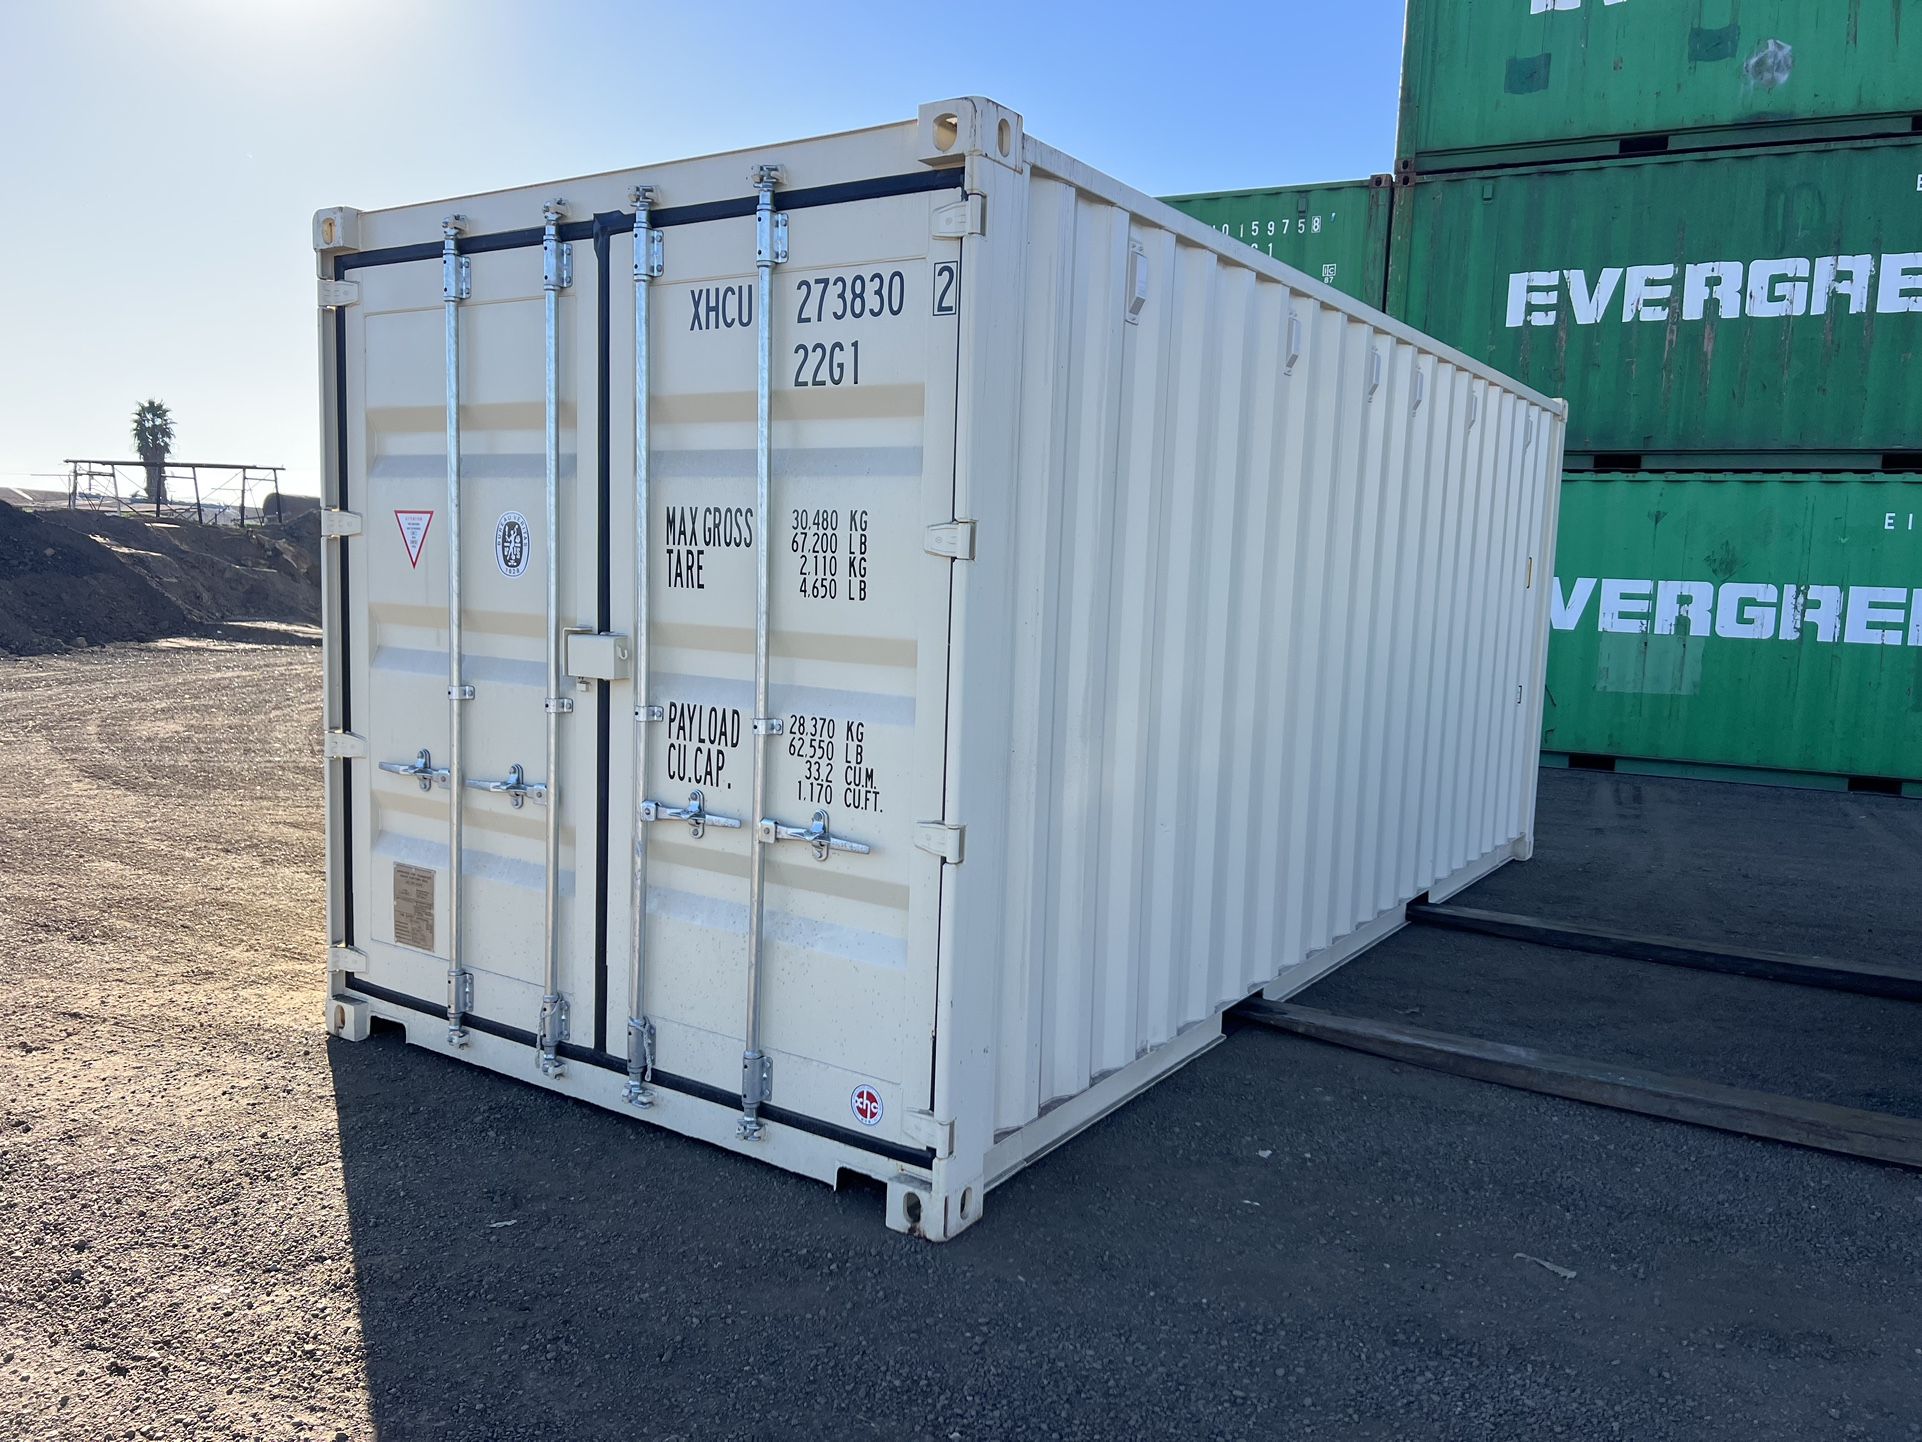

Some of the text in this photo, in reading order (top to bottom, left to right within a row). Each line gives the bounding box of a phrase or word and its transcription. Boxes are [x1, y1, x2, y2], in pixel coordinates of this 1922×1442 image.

[689, 264, 955, 331] XHCU 273830 2
[793, 340, 859, 387] 22G1
[666, 506, 868, 548] MAX GROSS 30,480 KG
[791, 531, 867, 555] 67,200 LB
[666, 548, 867, 589] TARE 2,110 KG
[799, 577, 867, 601] 4,650 LB
[1549, 575, 1922, 646] VERGRE
[668, 701, 865, 748] PAYLOAD 28,370 KG
[667, 742, 877, 789] CU.CAP. 33.2 CU.M.
[788, 736, 864, 765] 62,550 LB
[797, 780, 883, 813] 1,170 CU.FT.
